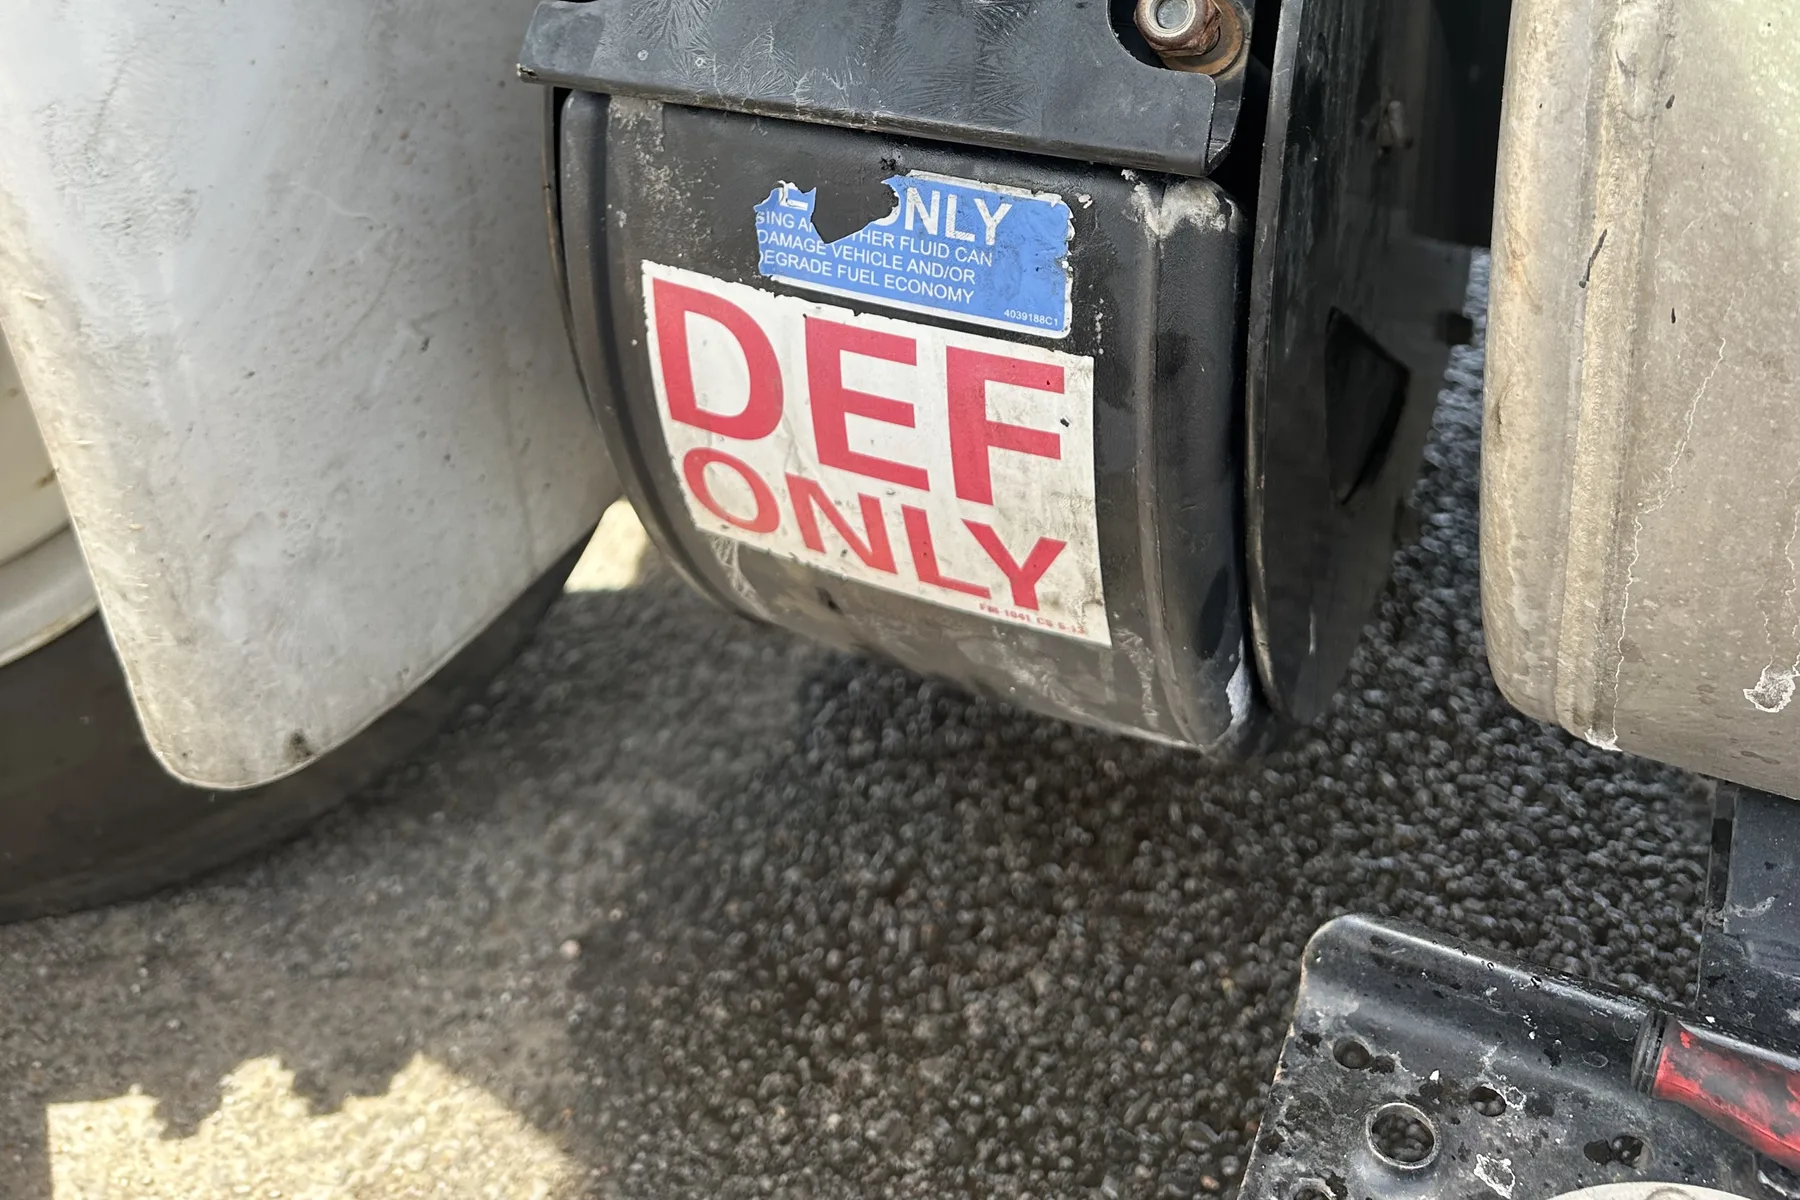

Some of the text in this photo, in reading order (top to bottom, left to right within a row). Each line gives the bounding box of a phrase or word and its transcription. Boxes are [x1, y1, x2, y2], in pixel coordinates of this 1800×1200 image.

[757, 229, 976, 285] DAMAGE VEHICLE AND/OR
[900, 236, 950, 259] FLUID
[955, 248, 993, 267] CAN
[837, 264, 880, 286] FUEL
[884, 274, 975, 305] ECONOMY
[1004, 309, 1059, 327] 4039188C1
[652, 276, 1066, 507] DEF
[682, 446, 1067, 612] ONLY
